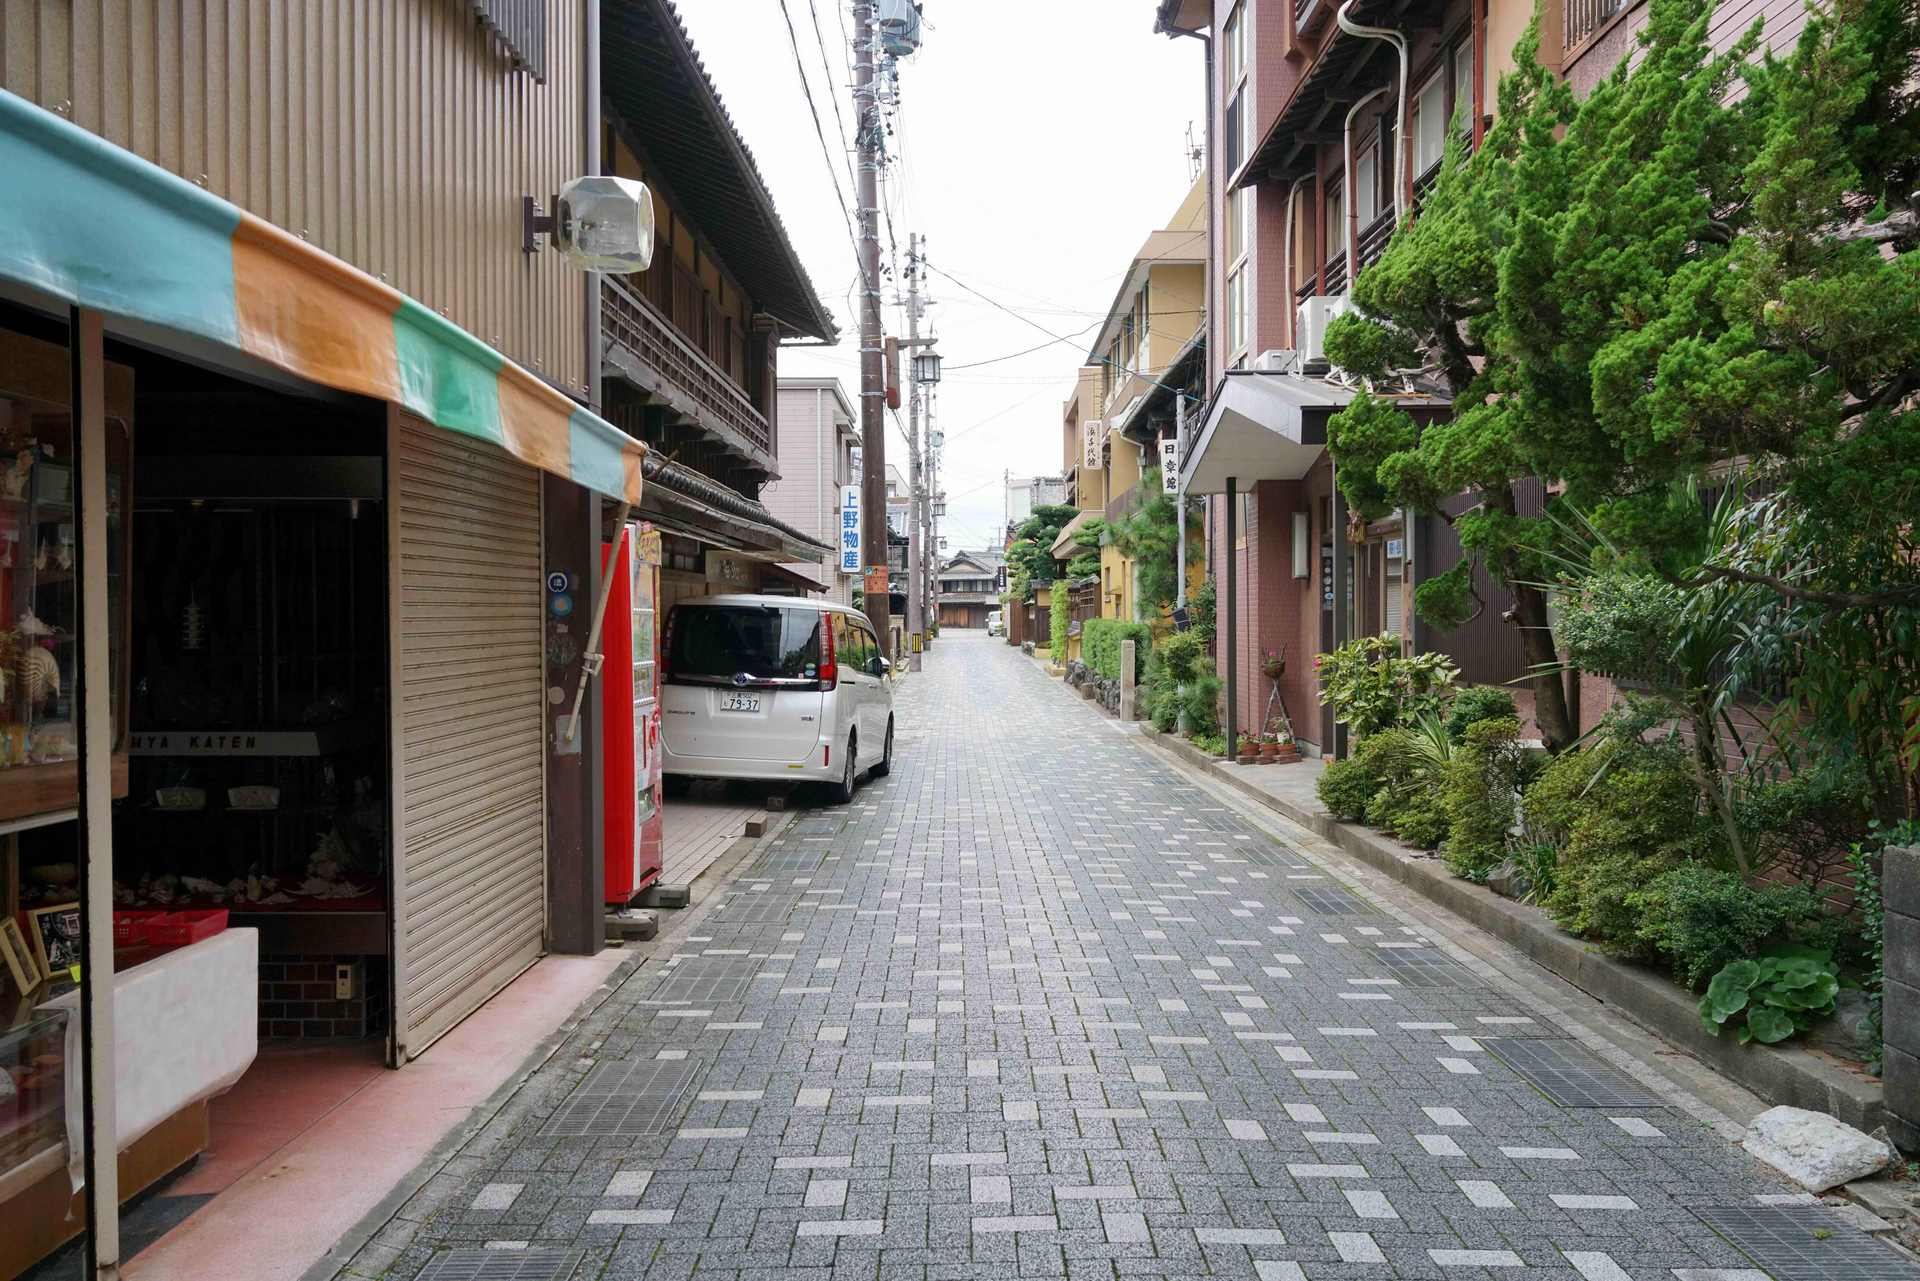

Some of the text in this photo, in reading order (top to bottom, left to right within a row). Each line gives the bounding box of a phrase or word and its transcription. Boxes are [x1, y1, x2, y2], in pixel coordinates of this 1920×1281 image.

[843, 491, 858, 568] 上野物産
[729, 698, 759, 710] 79-37
[189, 735, 256, 749] KATEN
